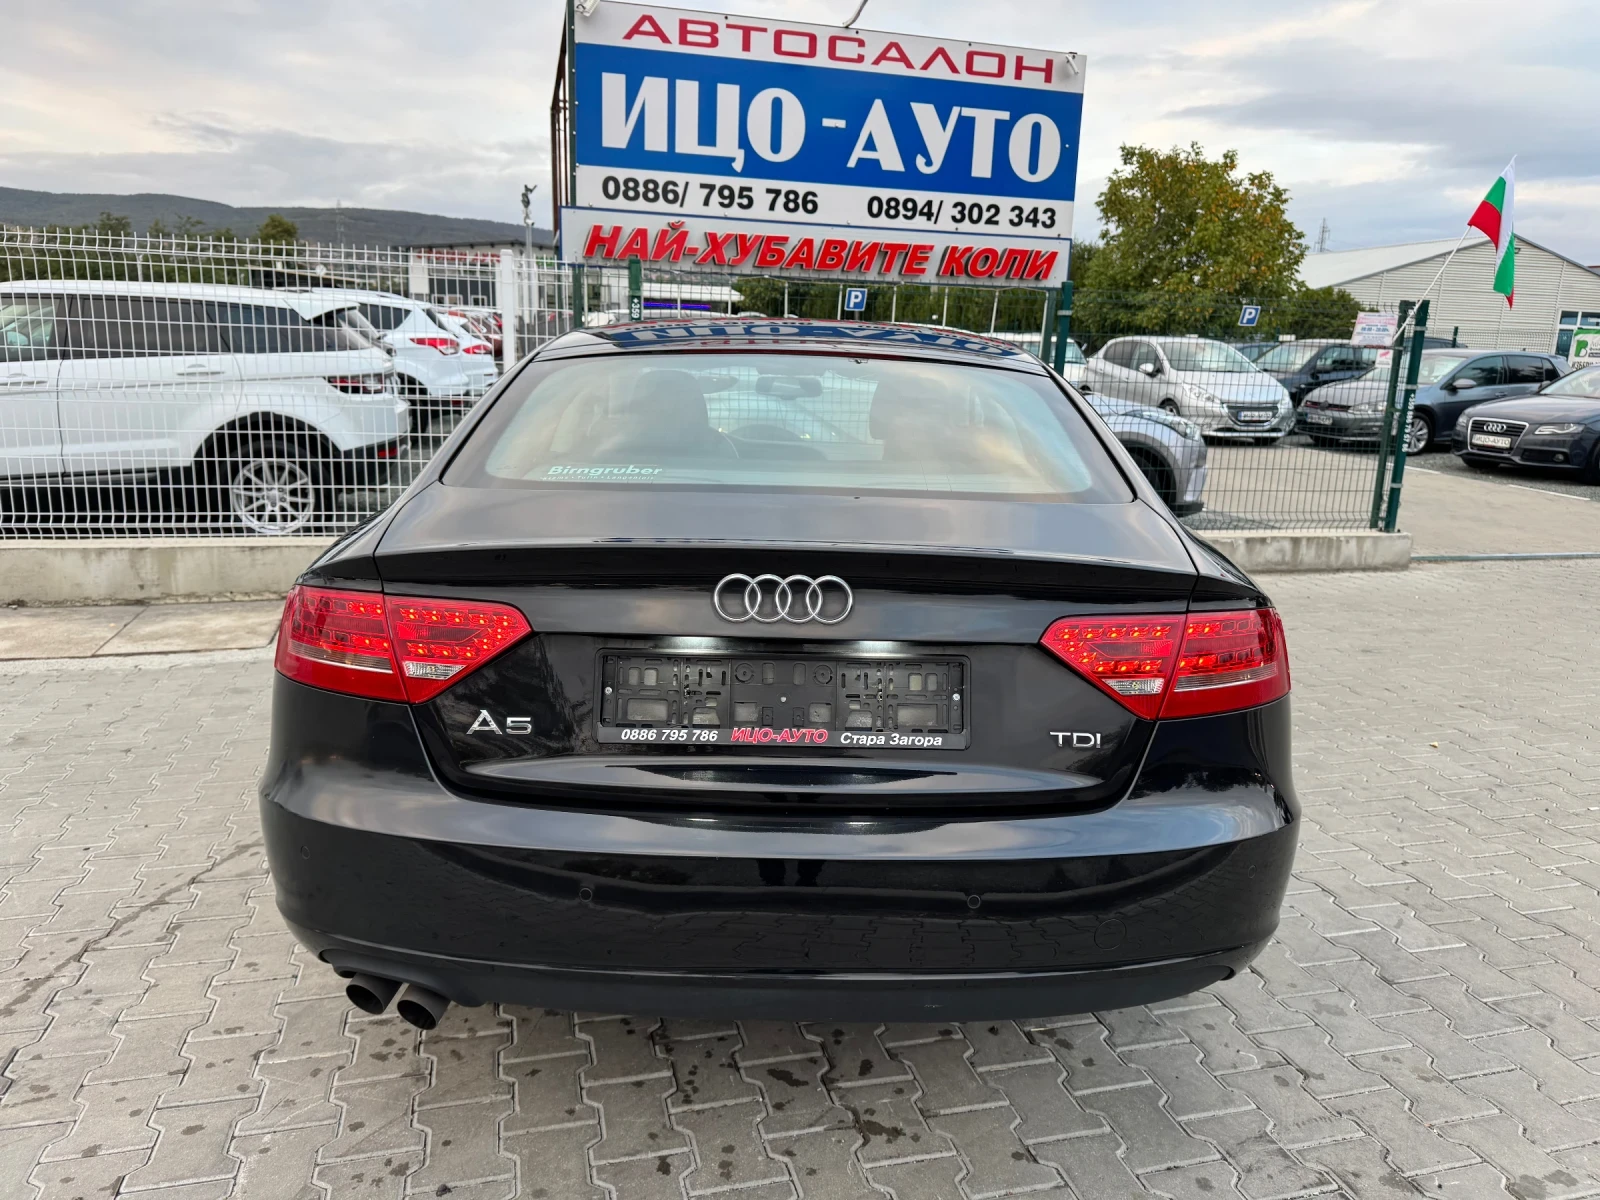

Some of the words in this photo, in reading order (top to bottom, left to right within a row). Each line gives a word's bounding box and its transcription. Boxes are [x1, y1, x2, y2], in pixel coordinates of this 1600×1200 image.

[622, 14, 1053, 84] АВТОСАЛОН
[602, 175, 689, 208] 0886/
[699, 183, 754, 210] 795
[765, 188, 819, 214] 786
[867, 196, 944, 224] 0894/
[951, 202, 1000, 225] 302
[1008, 205, 1056, 229] 343
[583, 220, 935, 276] НАЙ-ХУБАВИТЕ
[938, 244, 1059, 280] КОЛИ
[547, 464, 662, 476] Birngruber
[466, 709, 533, 735] A5
[621, 728, 657, 742] 0886
[661, 728, 687, 742] 795
[691, 729, 719, 742] 786
[731, 727, 829, 744] ИЦО-АУТО
[840, 732, 885, 747] Стара
[889, 732, 943, 747] Загора
[1050, 731, 1101, 749] TDI
